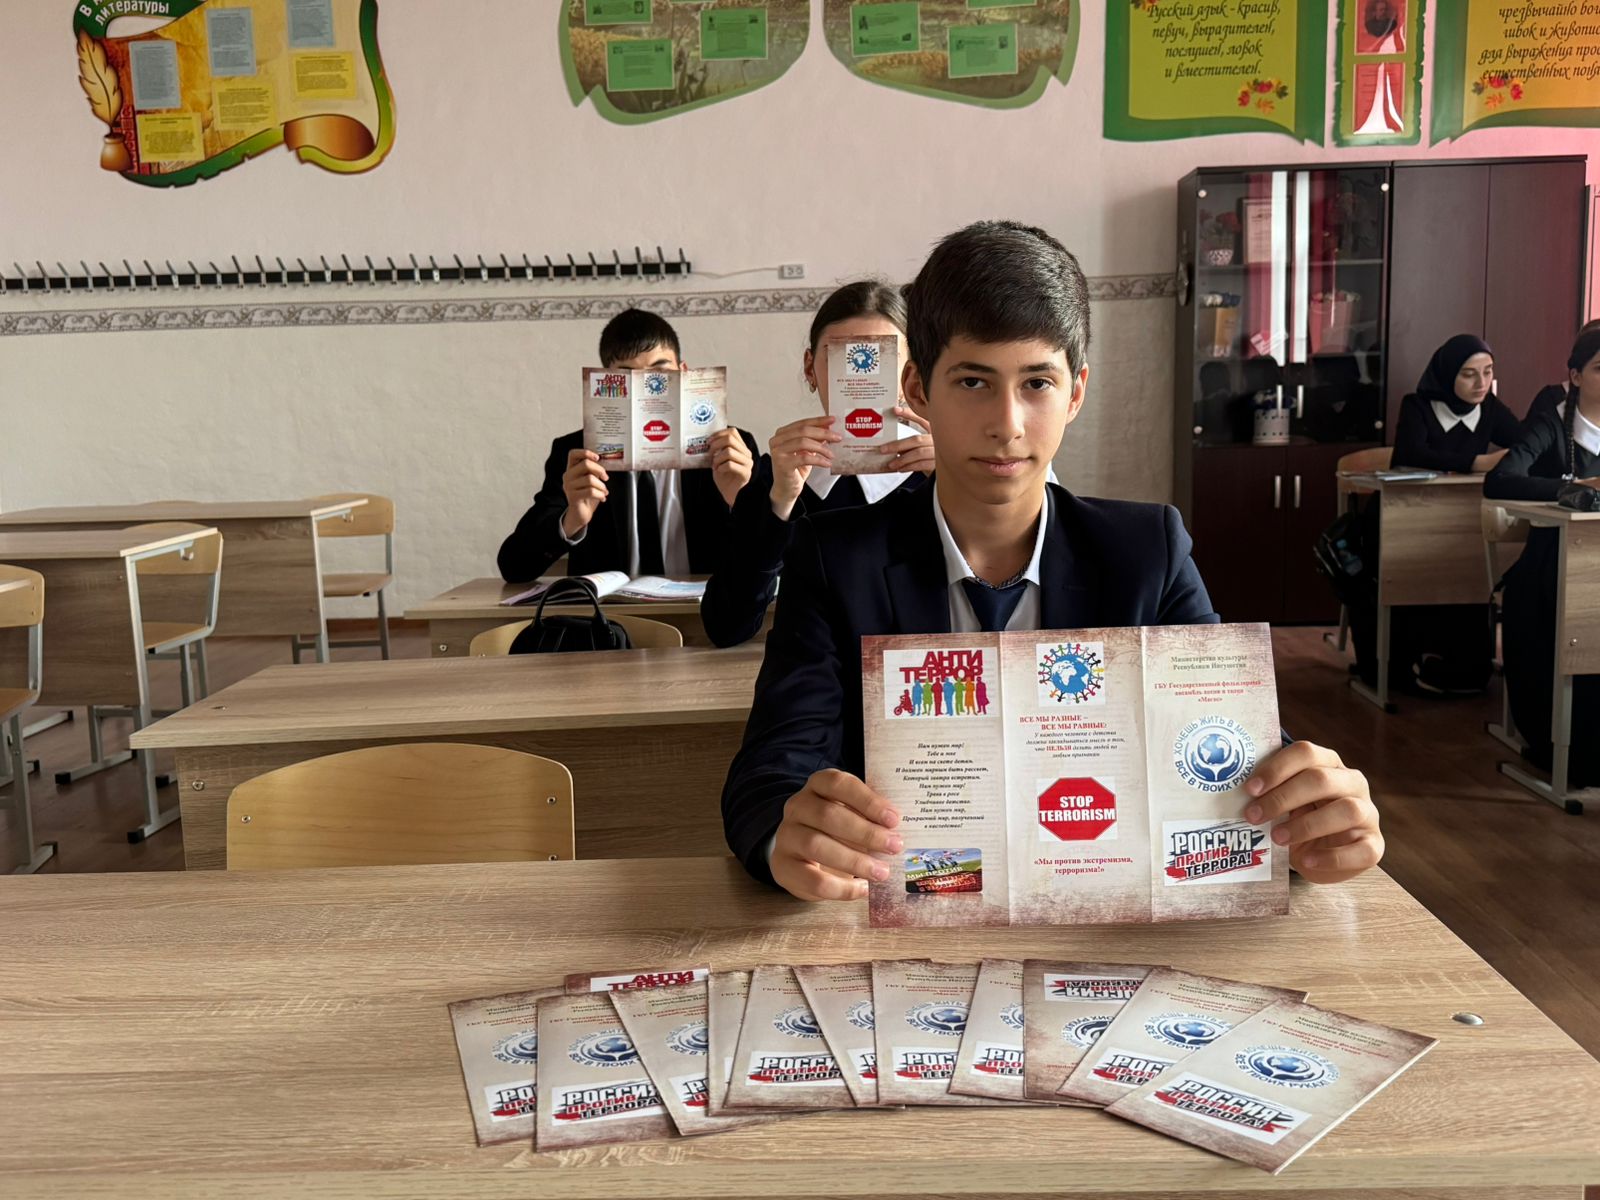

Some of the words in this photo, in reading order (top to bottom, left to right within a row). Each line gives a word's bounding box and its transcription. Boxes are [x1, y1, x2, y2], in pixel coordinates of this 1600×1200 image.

[95, 0, 169, 26] литературы
[1147, 2, 1194, 23] Русский
[1191, 0, 1228, 21] язык
[1499, 0, 1577, 23] чрезвычайно
[1152, 22, 1189, 43] певуч,
[1189, 18, 1276, 42] выразителен,
[1504, 22, 1537, 40] гибок
[1540, 27, 1547, 37] и
[1165, 38, 1225, 62] послушен,
[1226, 39, 1264, 61] ловок
[1478, 49, 1503, 65] для
[1502, 41, 1573, 65] выражения
[1164, 67, 1172, 78] и
[1172, 59, 1261, 84] вместителен.
[1482, 63, 1571, 83] естественных
[846, 422, 883, 430] TERRORISM
[922, 650, 983, 668] АНТИ
[899, 665, 984, 684] ТЕРРОР
[1174, 722, 1198, 754] ХОЧЕШЬ
[1199, 715, 1225, 726] ЖИТЬ
[1227, 719, 1234, 727] В
[1234, 724, 1255, 752] МИРЕ?
[1175, 760, 1190, 779] ВСЕ
[1188, 777, 1197, 786] В
[1198, 781, 1232, 792] ТВОИХ
[1232, 756, 1255, 786] РУКАХ!
[1060, 795, 1094, 808] STOP
[1039, 808, 1116, 822] TERRORISM
[1173, 829, 1253, 855] РОССИЯ
[1054, 858, 1081, 866] против
[1176, 846, 1231, 868] ПРОТИВ
[1185, 852, 1252, 877] ТЕРРОРА!
[925, 867, 964, 877] ПРОТИВ
[632, 971, 695, 983] АНТИ
[760, 1065, 830, 1077] ПРОТИВ
[1249, 1071, 1286, 1087] ТВОИХ
[566, 1094, 638, 1114] ПРОТИВ
[1168, 1090, 1243, 1114] ПРОТИВ
[1178, 1079, 1280, 1122] РОССИЯ
[1174, 1100, 1267, 1129] ТЕРРОРА!
